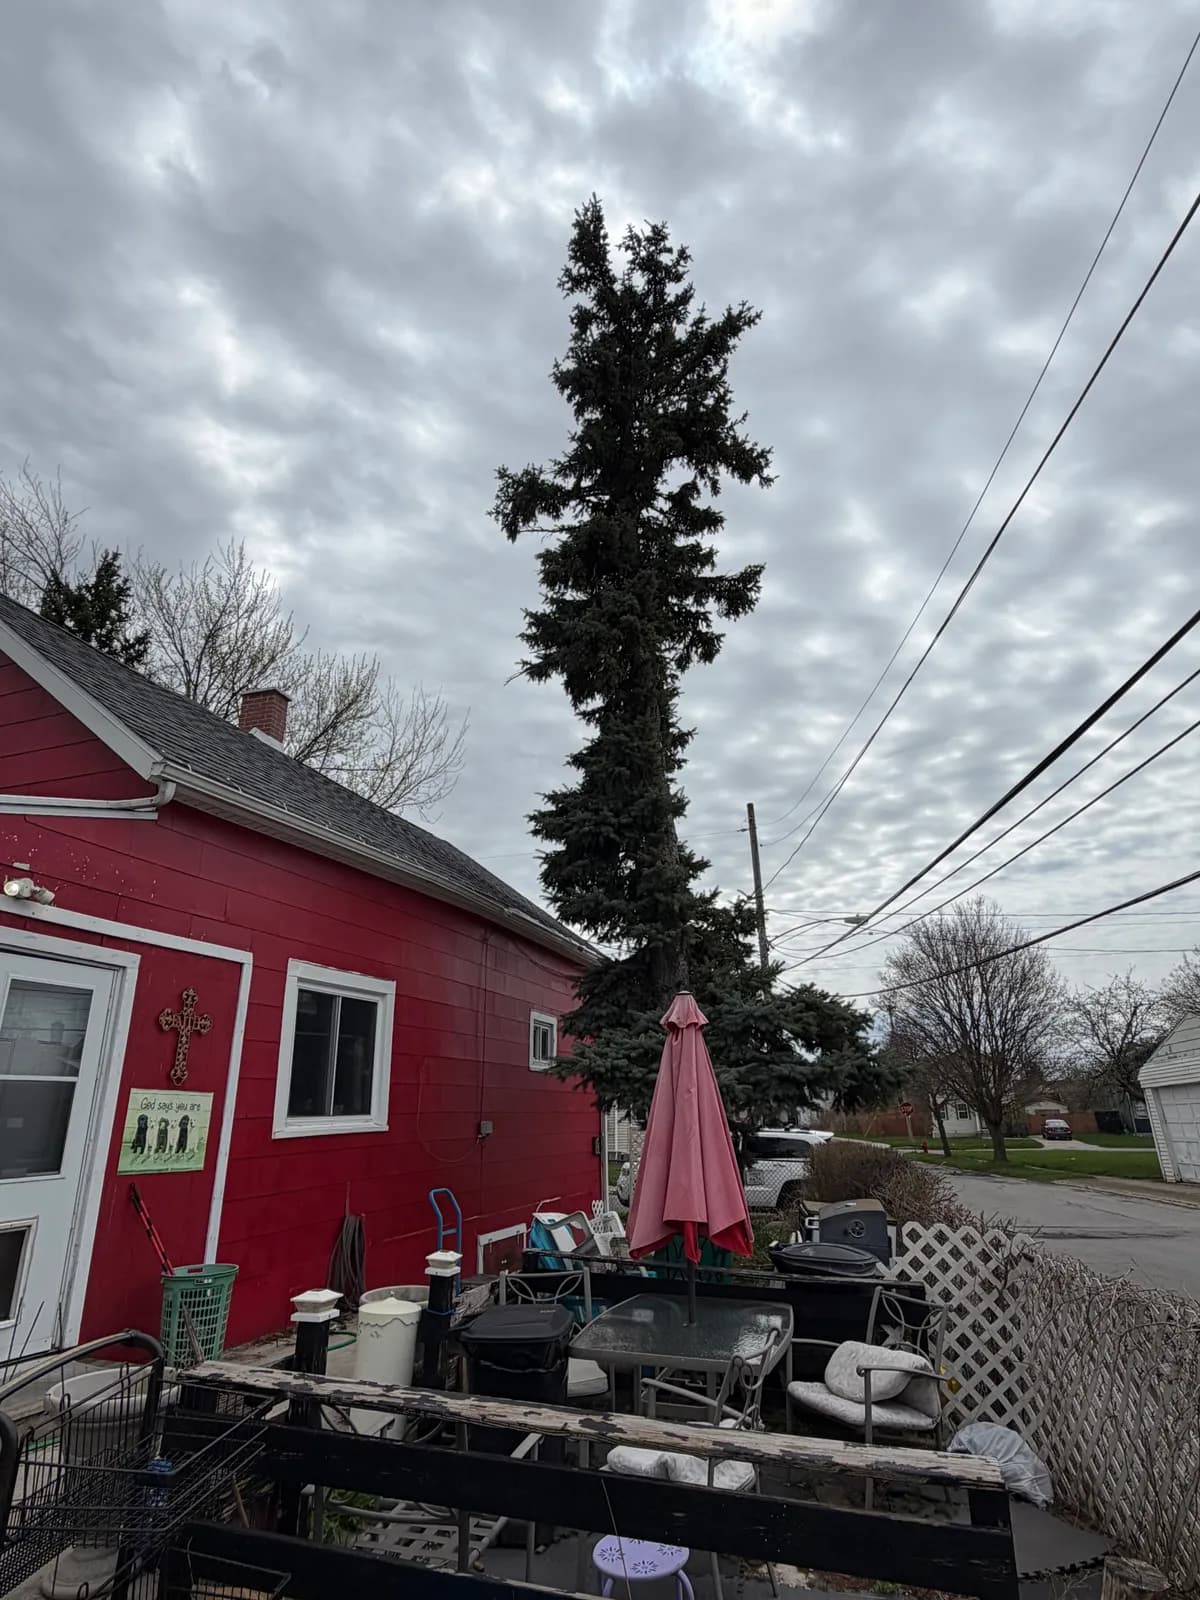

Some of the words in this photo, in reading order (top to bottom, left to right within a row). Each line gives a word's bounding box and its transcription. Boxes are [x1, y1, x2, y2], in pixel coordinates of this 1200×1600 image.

[141, 1097, 156, 1110] God
[157, 1102, 173, 1113] says
[175, 1102, 187, 1113] you
[189, 1102, 201, 1111] are
